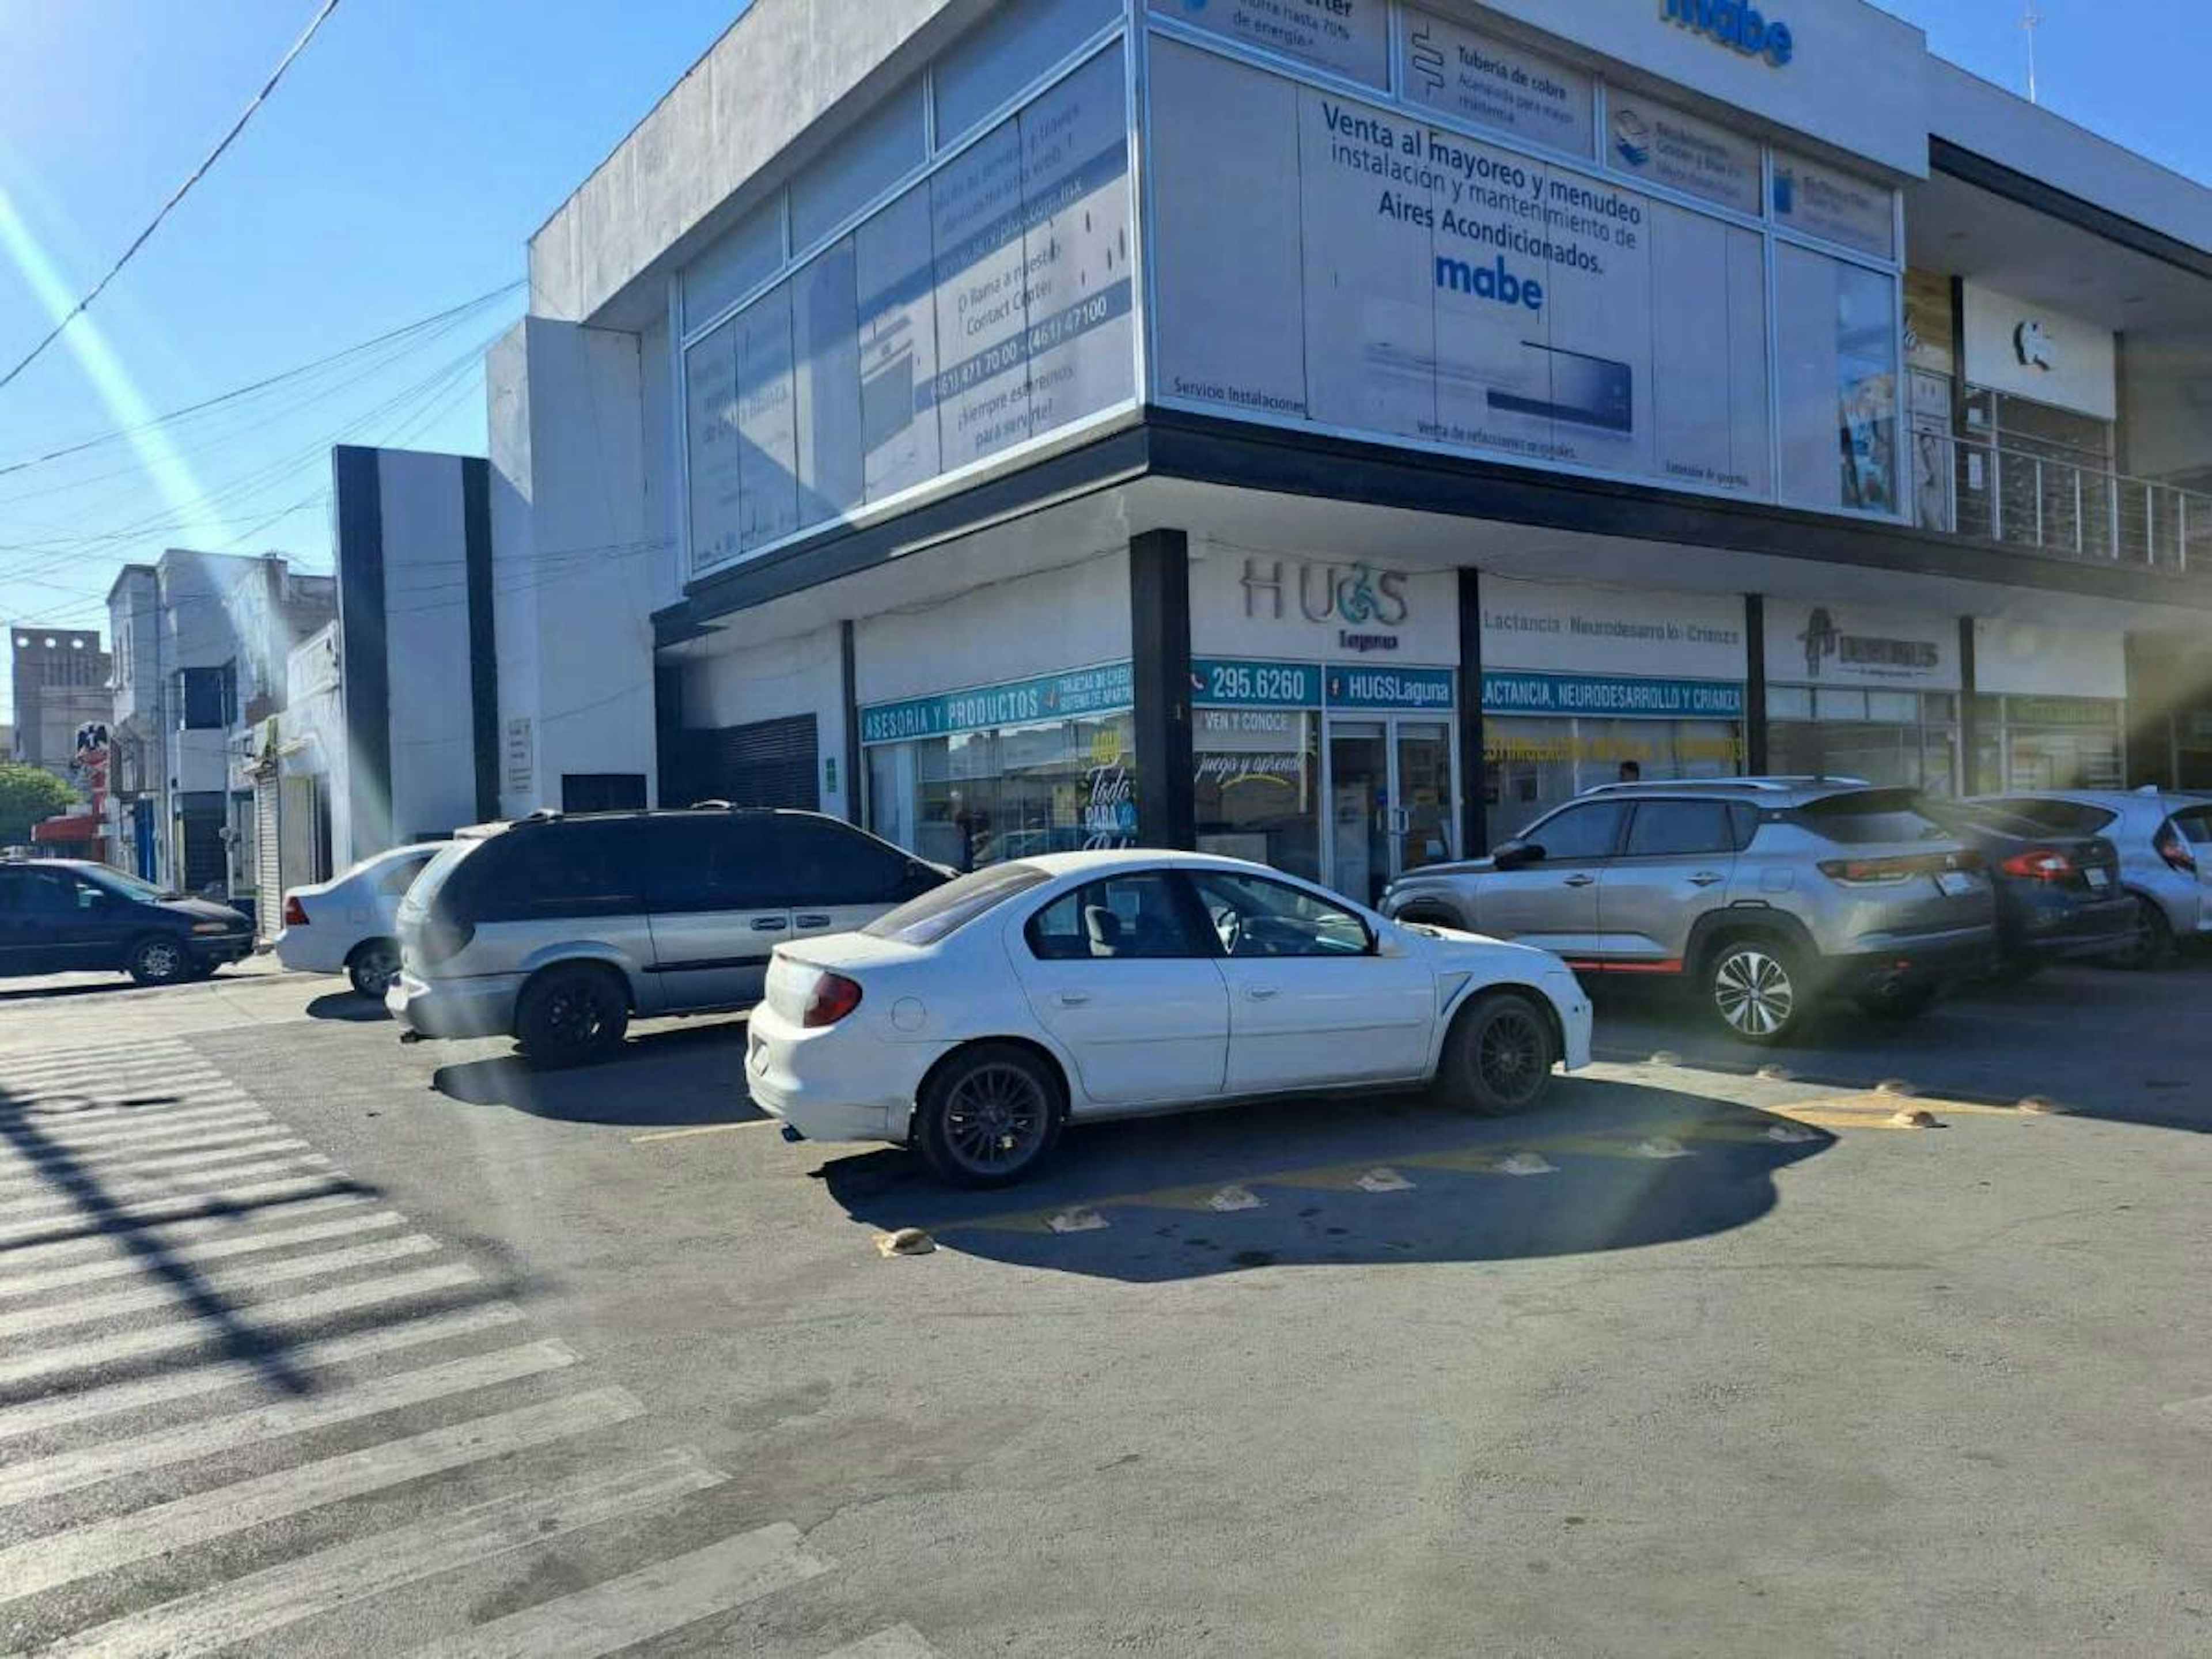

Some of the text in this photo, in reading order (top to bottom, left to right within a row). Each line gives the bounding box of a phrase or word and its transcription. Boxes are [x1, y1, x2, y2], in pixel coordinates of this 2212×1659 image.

[1323, 101, 1393, 149] Venta
[1402, 128, 1422, 162] al
[1430, 138, 1525, 190] mayoreo
[1532, 175, 1544, 197] y
[1550, 179, 1641, 226] menudeo
[1332, 137, 1637, 250] instalación y mantenimiento de
[1378, 190, 1605, 275] Aires Acondicionados.
[1435, 253, 1543, 310] mabe
[1173, 375, 1225, 399] Servicio
[1484, 609, 1561, 632] Lactancia
[1213, 666, 1305, 700] 295.6260
[1349, 675, 1449, 703] HUGSLaguna
[1558, 683, 1680, 710] NEURODESARROLLO
[1681, 688, 1691, 709] Y
[1692, 690, 1741, 711] CRIANZA
[933, 706, 942, 730] Y
[948, 690, 1038, 729] PRODUCTOS
[1241, 713, 1289, 731] CONOCE
